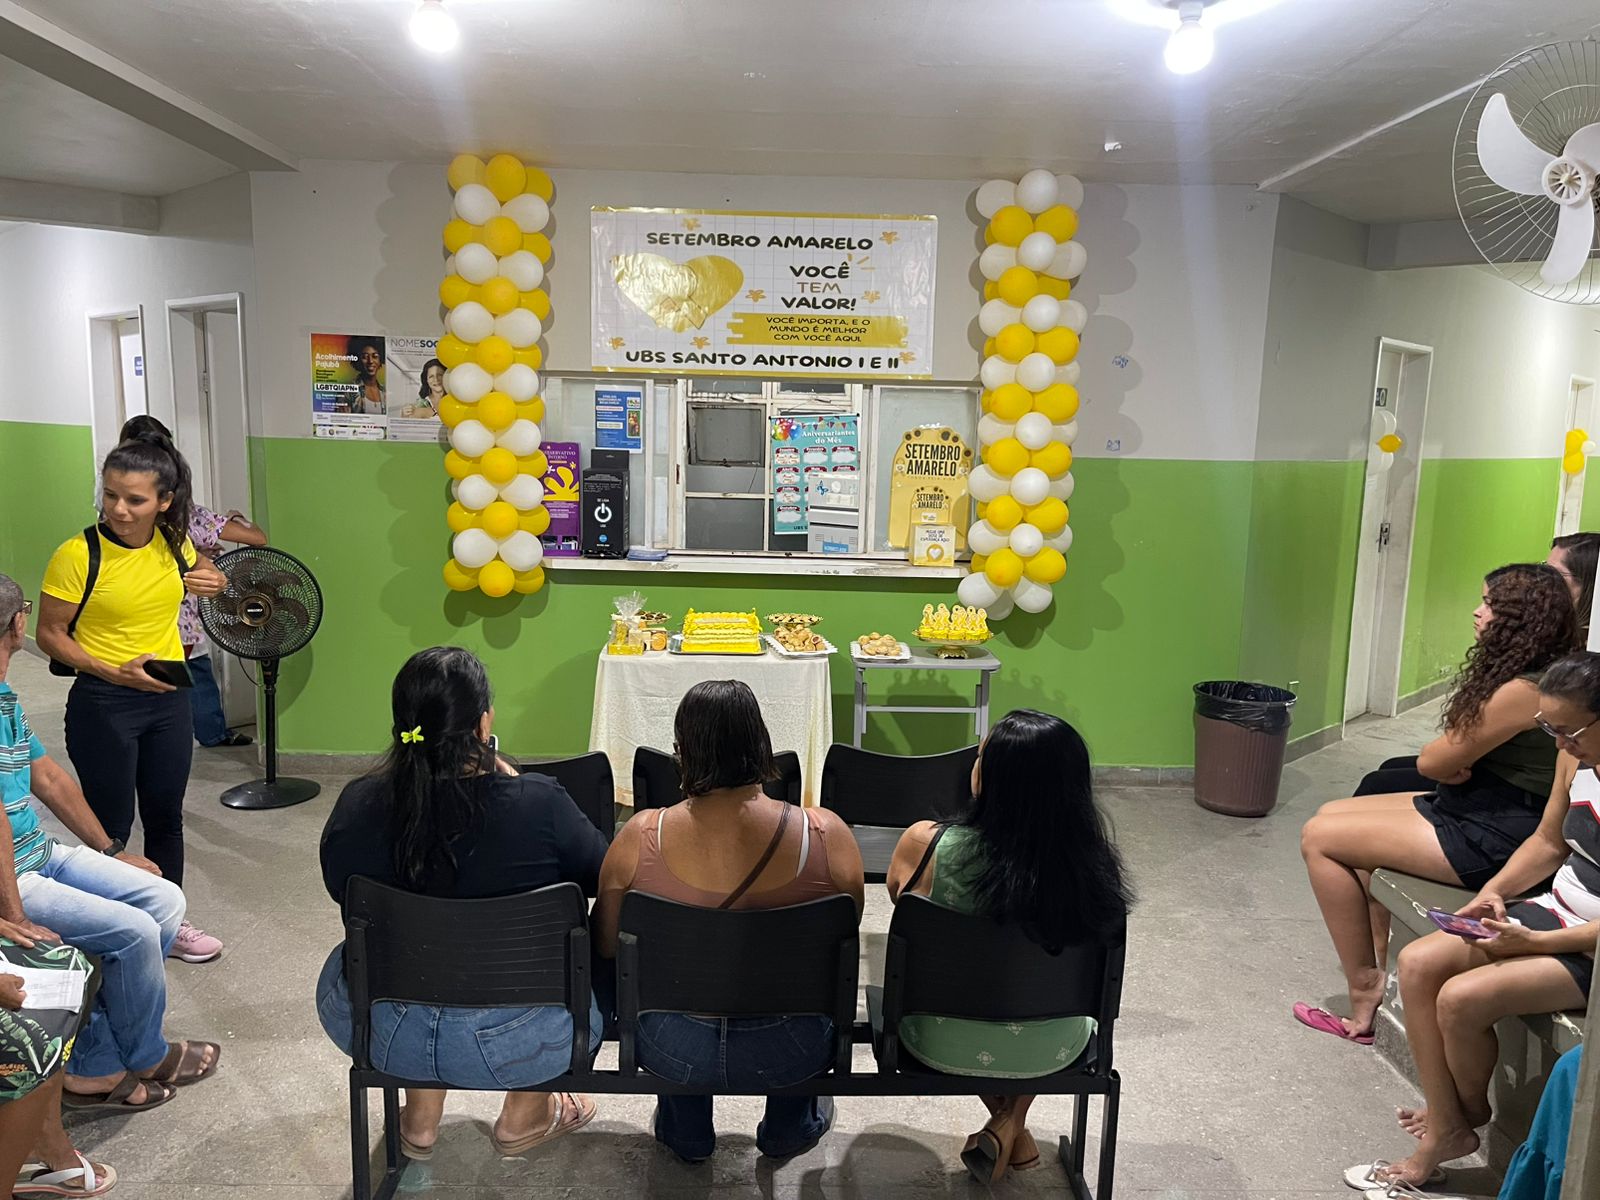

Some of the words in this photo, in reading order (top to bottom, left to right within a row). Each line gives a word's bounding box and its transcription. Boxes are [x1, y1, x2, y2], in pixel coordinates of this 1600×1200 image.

[646, 232, 761, 248] SETEMBRO
[767, 235, 874, 250] AMARELO
[789, 261, 850, 279] VOCÊ
[796, 282, 842, 294] TEM
[781, 296, 857, 311] VALOR!
[316, 353, 358, 362] Acolhimento
[626, 350, 666, 363] UBS
[672, 352, 746, 365] SANTO
[753, 354, 852, 368] ANTONIO
[858, 357, 864, 368] I
[870, 357, 882, 369] E
[888, 357, 898, 369] II
[905, 443, 960, 461] SETEMBRO
[906, 460, 957, 477] AMARELO
[916, 494, 944, 502] SETEMBRO
